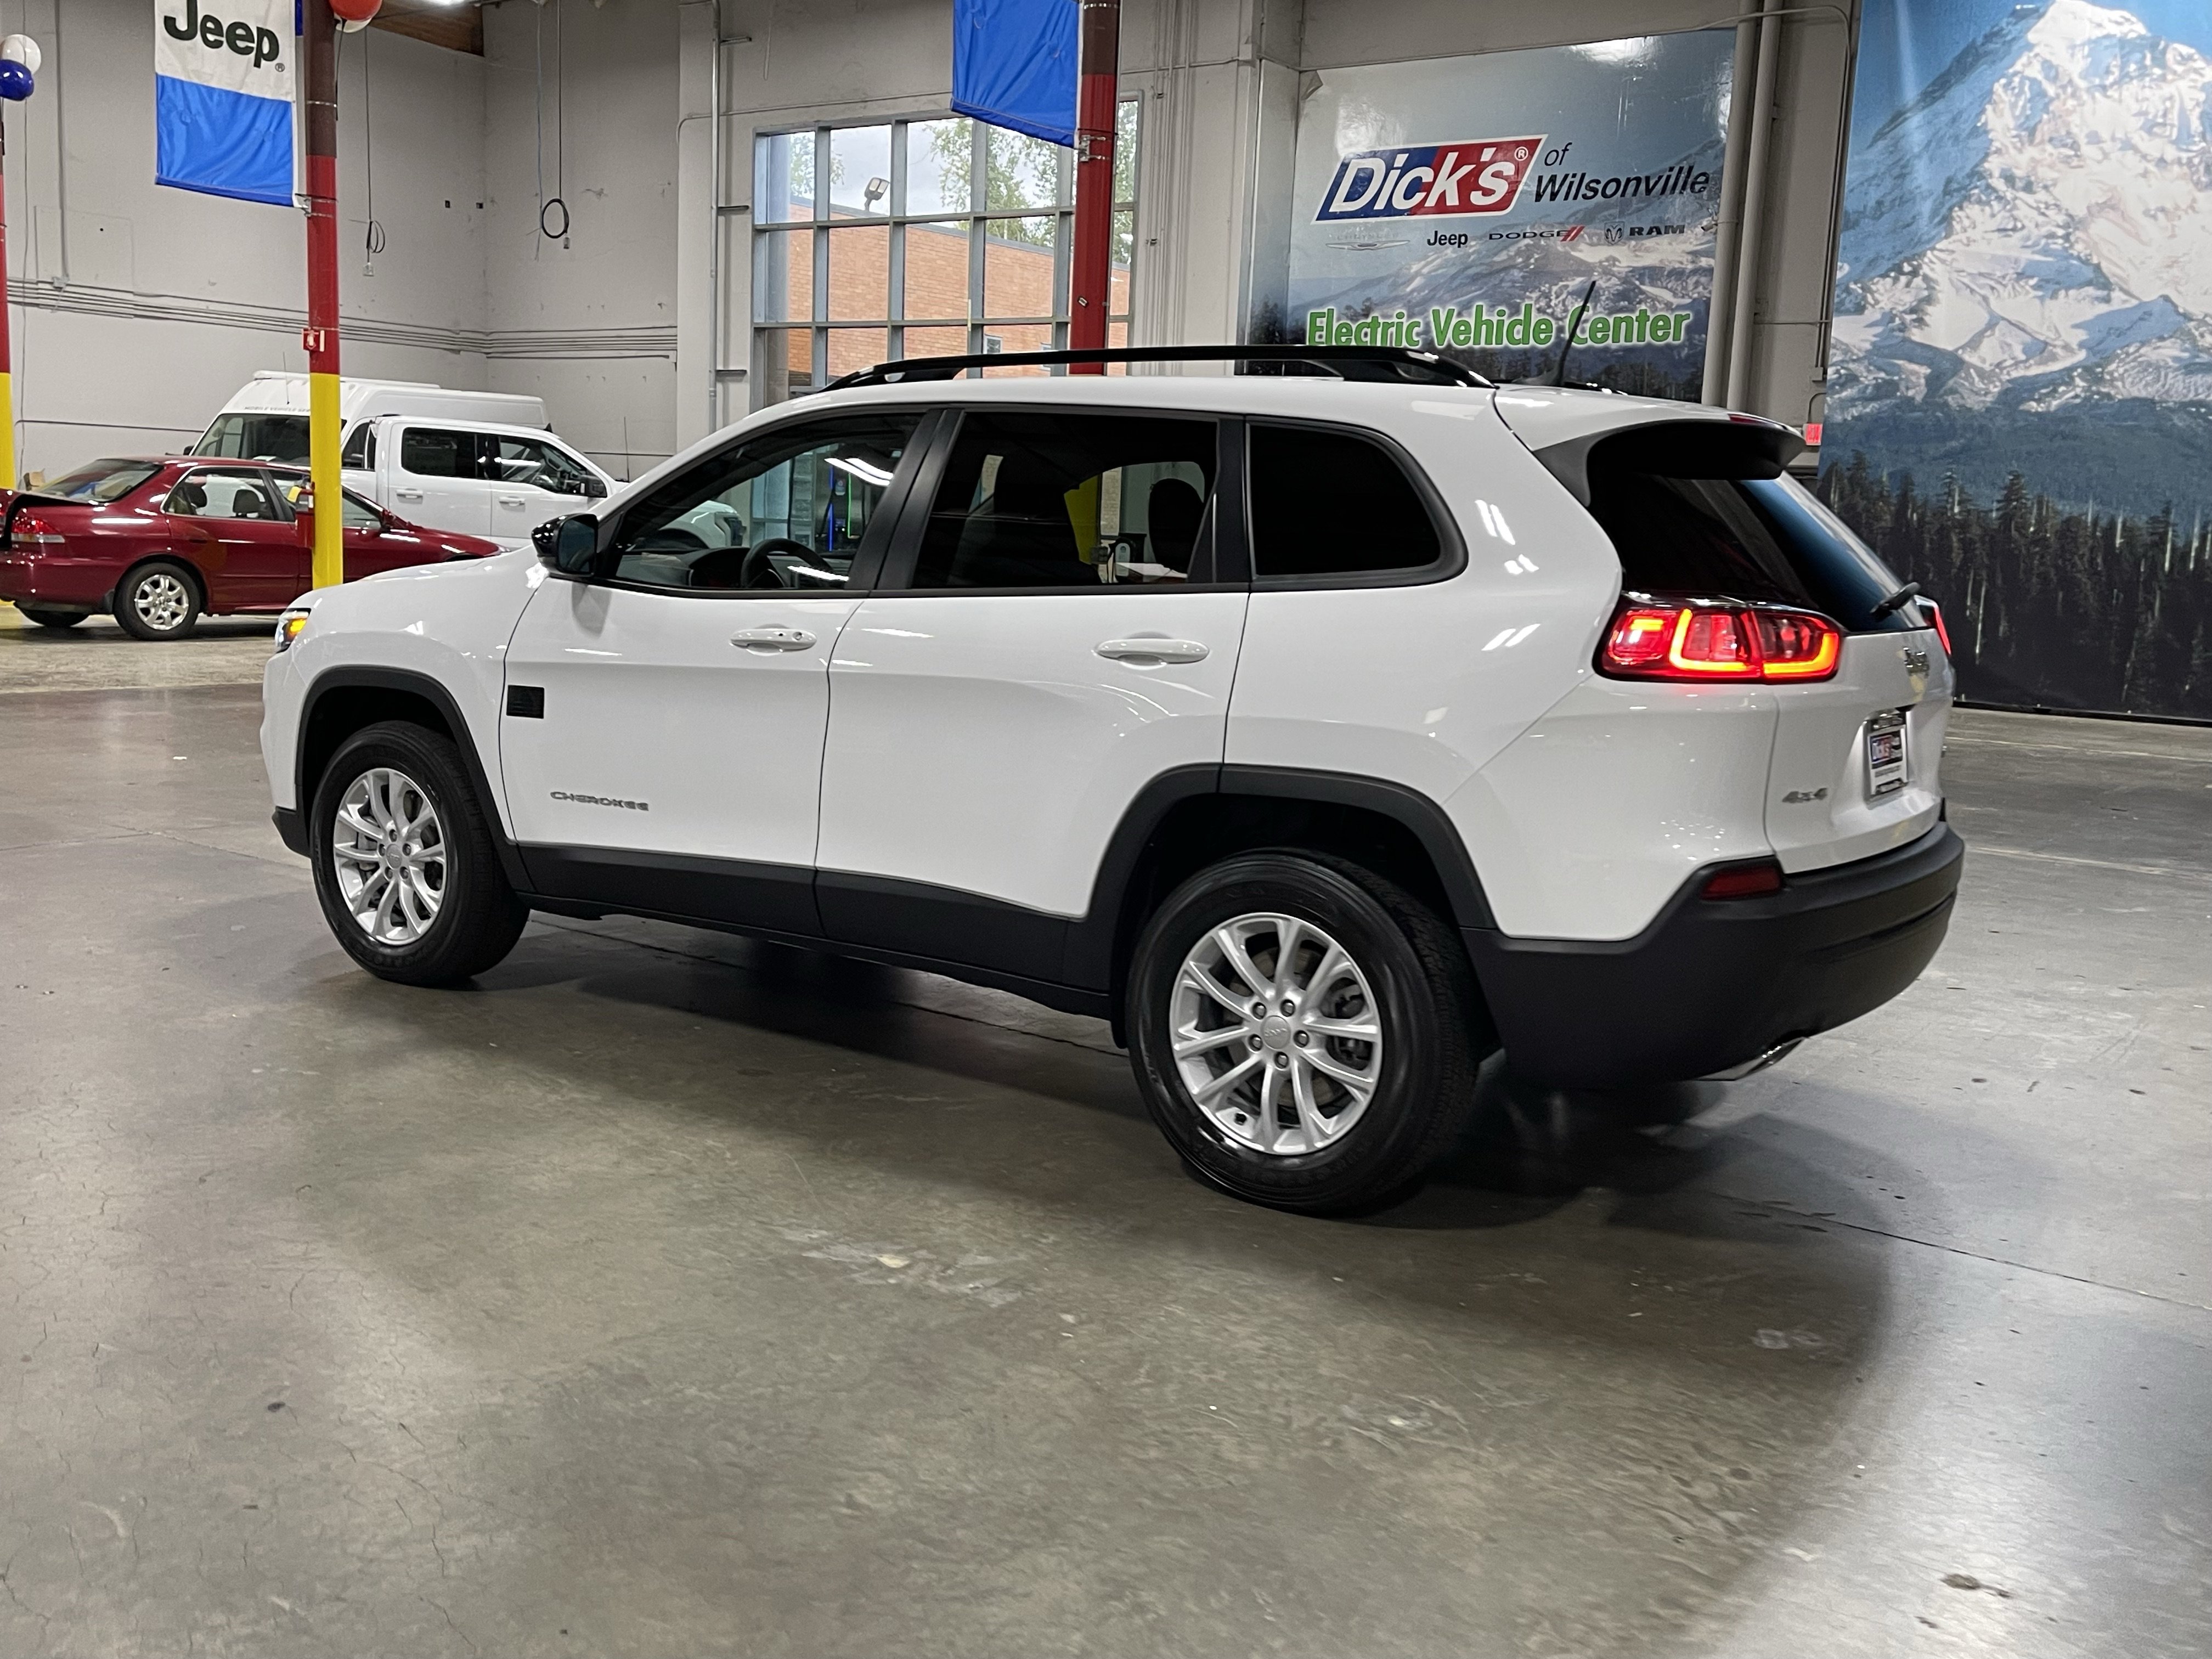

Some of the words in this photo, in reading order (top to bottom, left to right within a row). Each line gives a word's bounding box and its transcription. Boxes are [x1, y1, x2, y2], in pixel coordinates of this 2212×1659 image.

[163, 0, 279, 69] Jeep
[1544, 142, 1572, 166] of
[1328, 147, 1515, 212] Dick's
[1534, 164, 1710, 202] Wilsonville
[1427, 230, 1468, 247] Jeep
[1489, 229, 1570, 240] DODGE
[1629, 224, 1685, 236] RAM
[1308, 308, 1421, 347] Electric
[1432, 303, 1553, 347] Vehicle
[1568, 305, 1691, 345] Center
[550, 791, 649, 811] CHEROKEE
